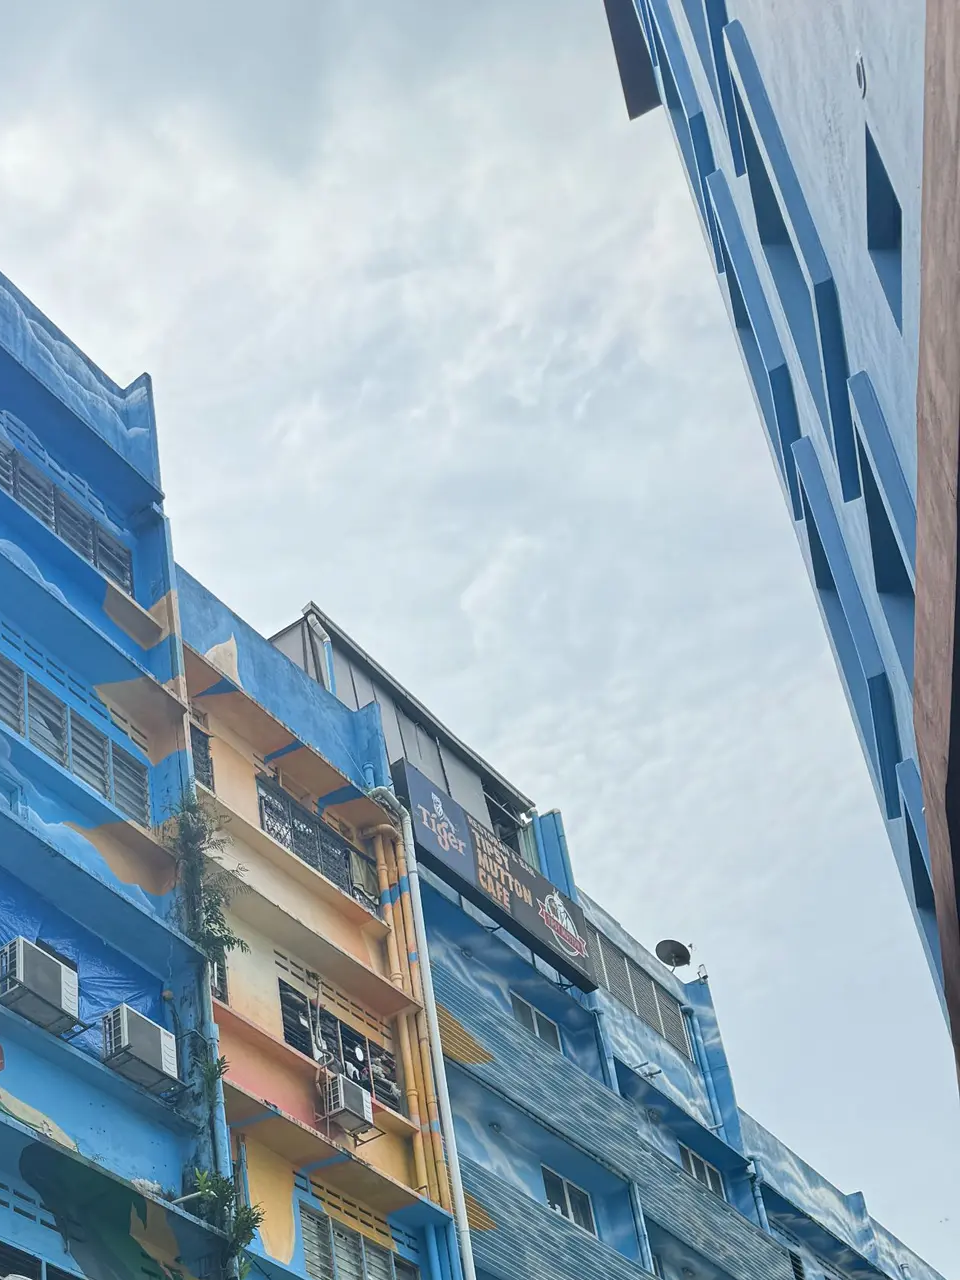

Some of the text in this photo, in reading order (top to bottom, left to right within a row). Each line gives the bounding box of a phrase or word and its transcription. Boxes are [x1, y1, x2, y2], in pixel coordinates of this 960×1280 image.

[417, 803, 467, 856] Tiger
[471, 828, 510, 871] TIPSY
[476, 848, 534, 907] MUTTON
[478, 867, 511, 909] CAFE
